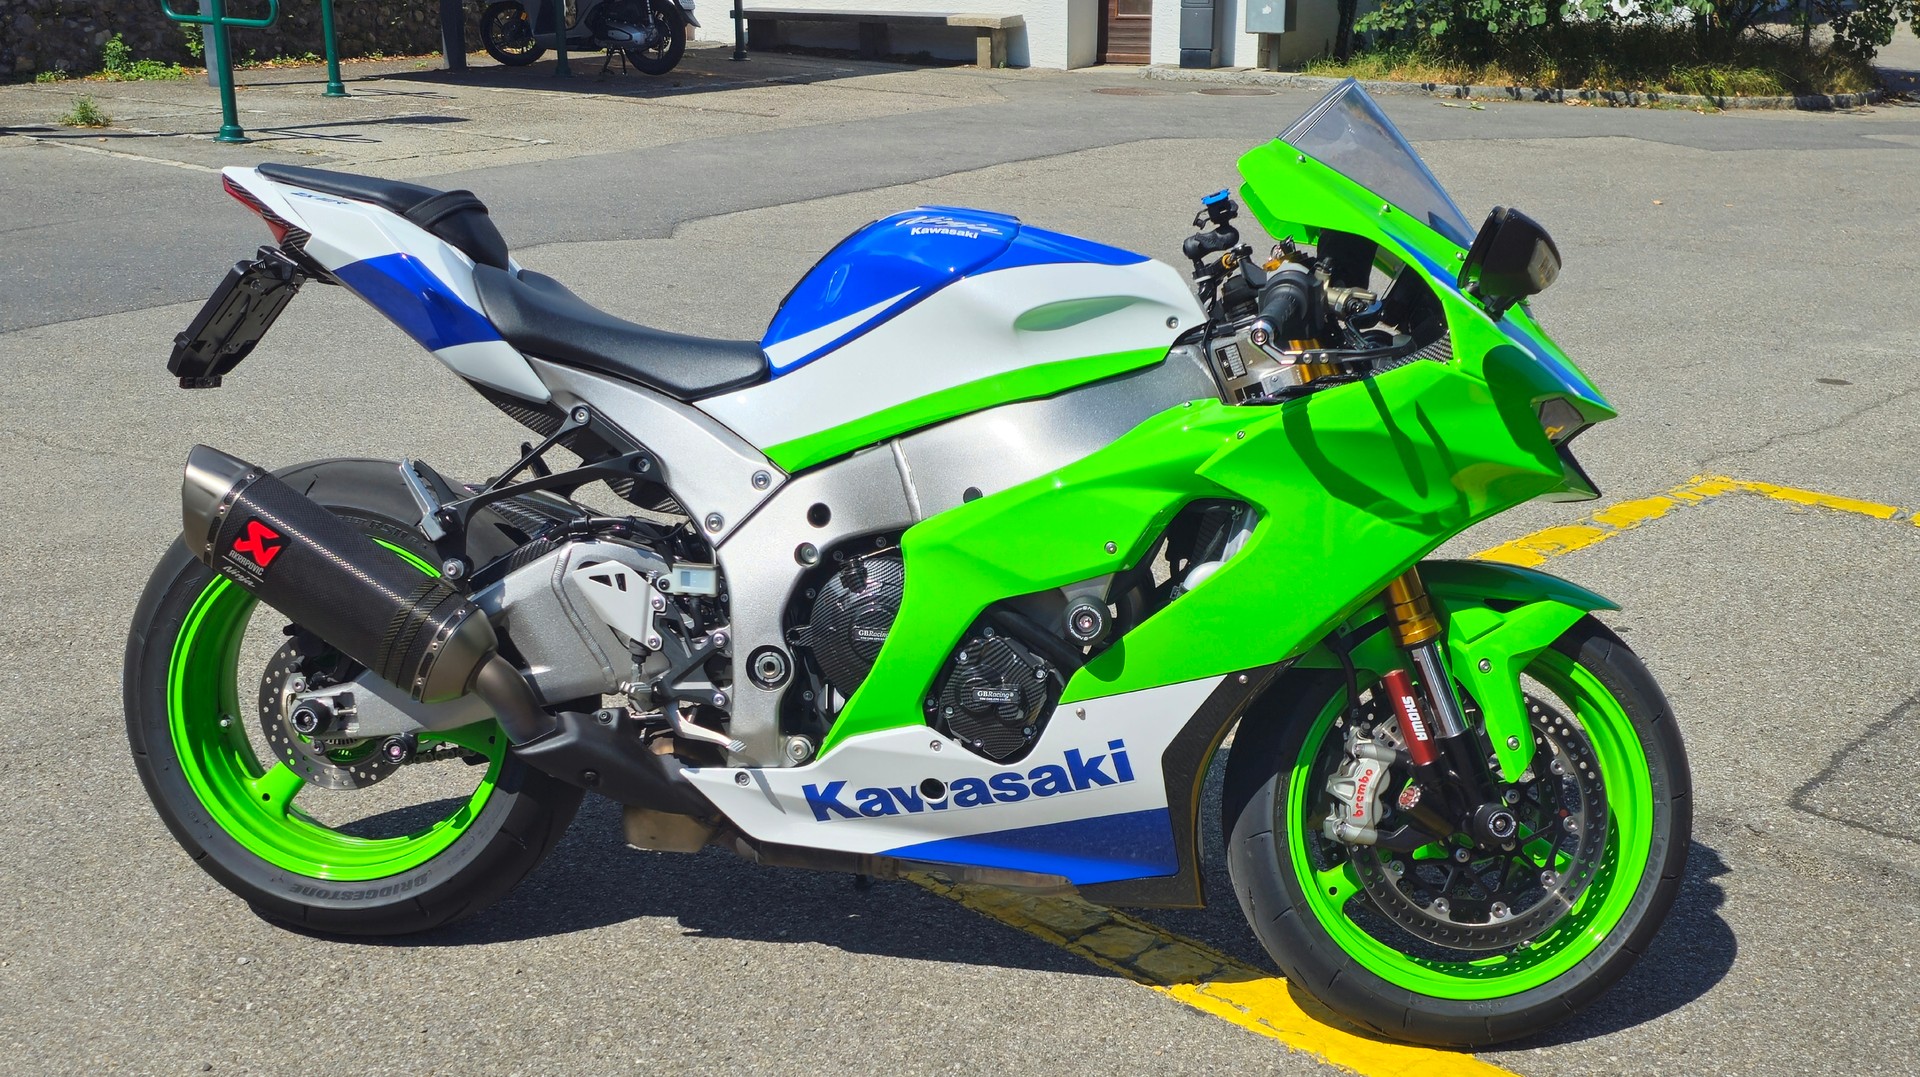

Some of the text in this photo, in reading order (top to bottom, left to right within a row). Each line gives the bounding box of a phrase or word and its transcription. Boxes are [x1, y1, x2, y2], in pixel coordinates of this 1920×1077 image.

[910, 227, 979, 240] Kawasaki
[223, 565, 256, 588] Ninja
[1401, 695, 1428, 741] SHOWA
[801, 738, 1136, 823] Kawasaki
[1353, 769, 1373, 818] brembo
[289, 870, 433, 901] BRIDGESTONE
